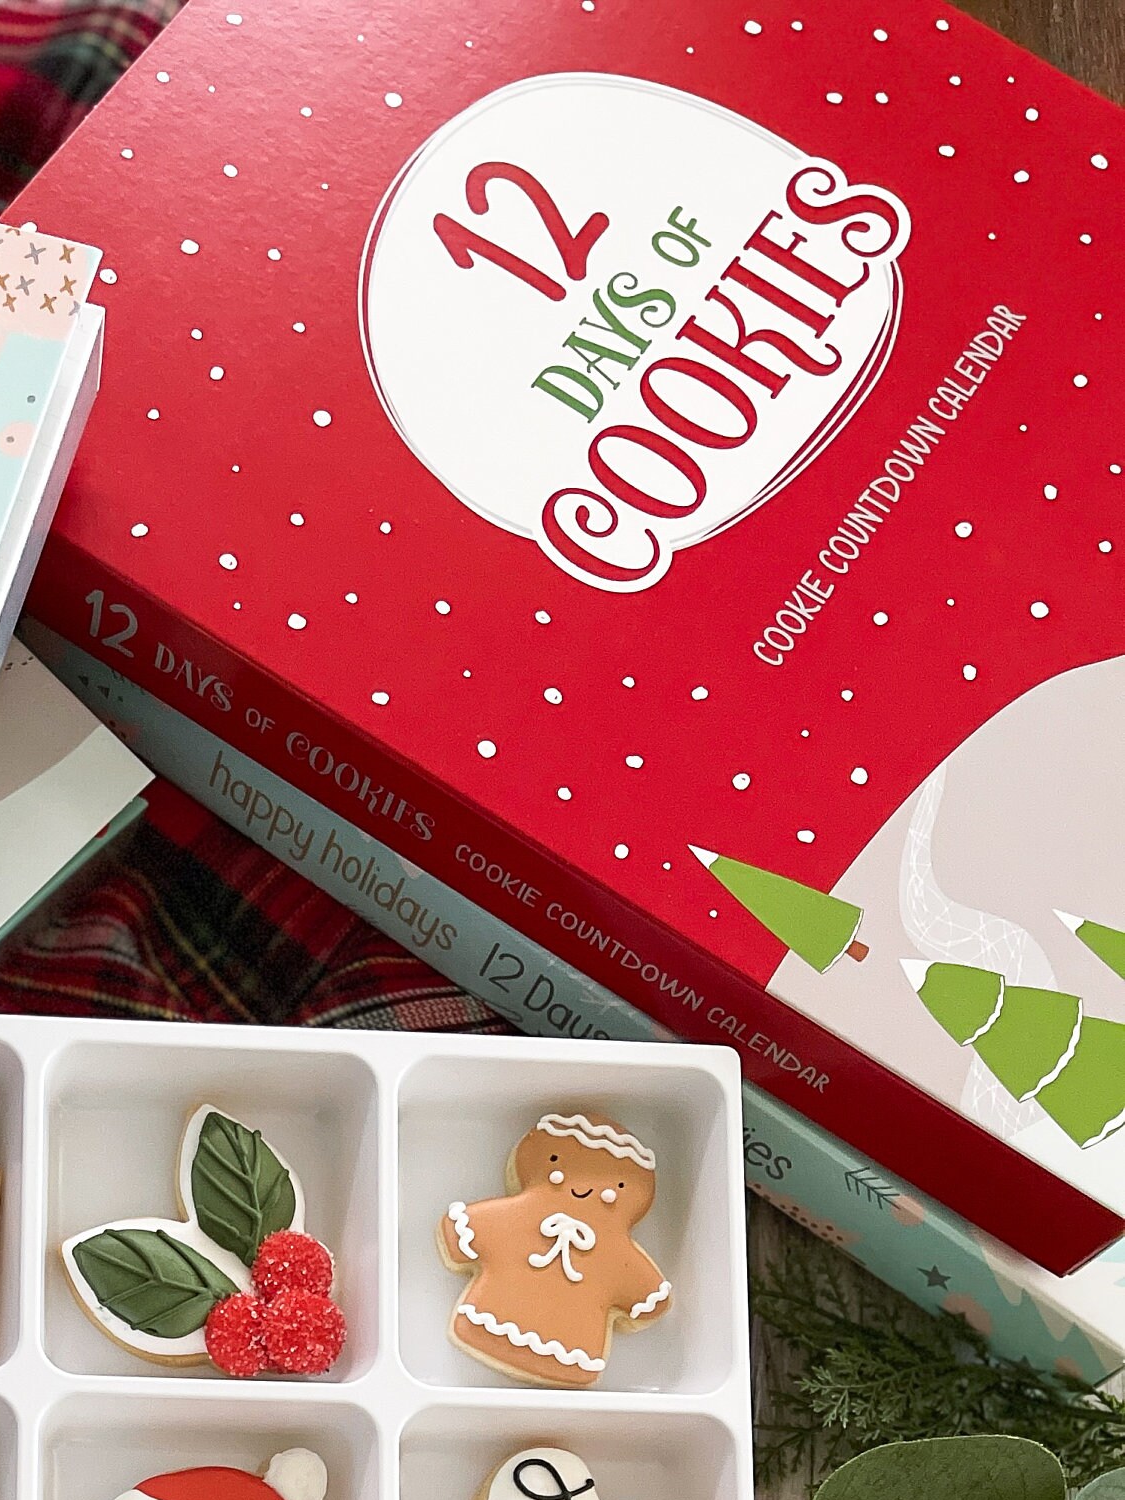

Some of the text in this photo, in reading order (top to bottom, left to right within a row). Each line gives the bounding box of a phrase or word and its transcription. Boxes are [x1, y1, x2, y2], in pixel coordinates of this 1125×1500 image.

[433, 161, 610, 302] 12
[531, 205, 713, 424] DAYS OF
[542, 166, 899, 582] COOKIES
[753, 303, 1027, 667] COOKIE COUNTDOWN CALENDAR
[85, 589, 436, 841] 12 DAYS OF COOKIES
[208, 751, 315, 862] happy
[319, 829, 460, 952] holidays
[479, 942, 526, 994] 12
[455, 844, 831, 1095] COOKIE COUNTDOWN CALENDAR
